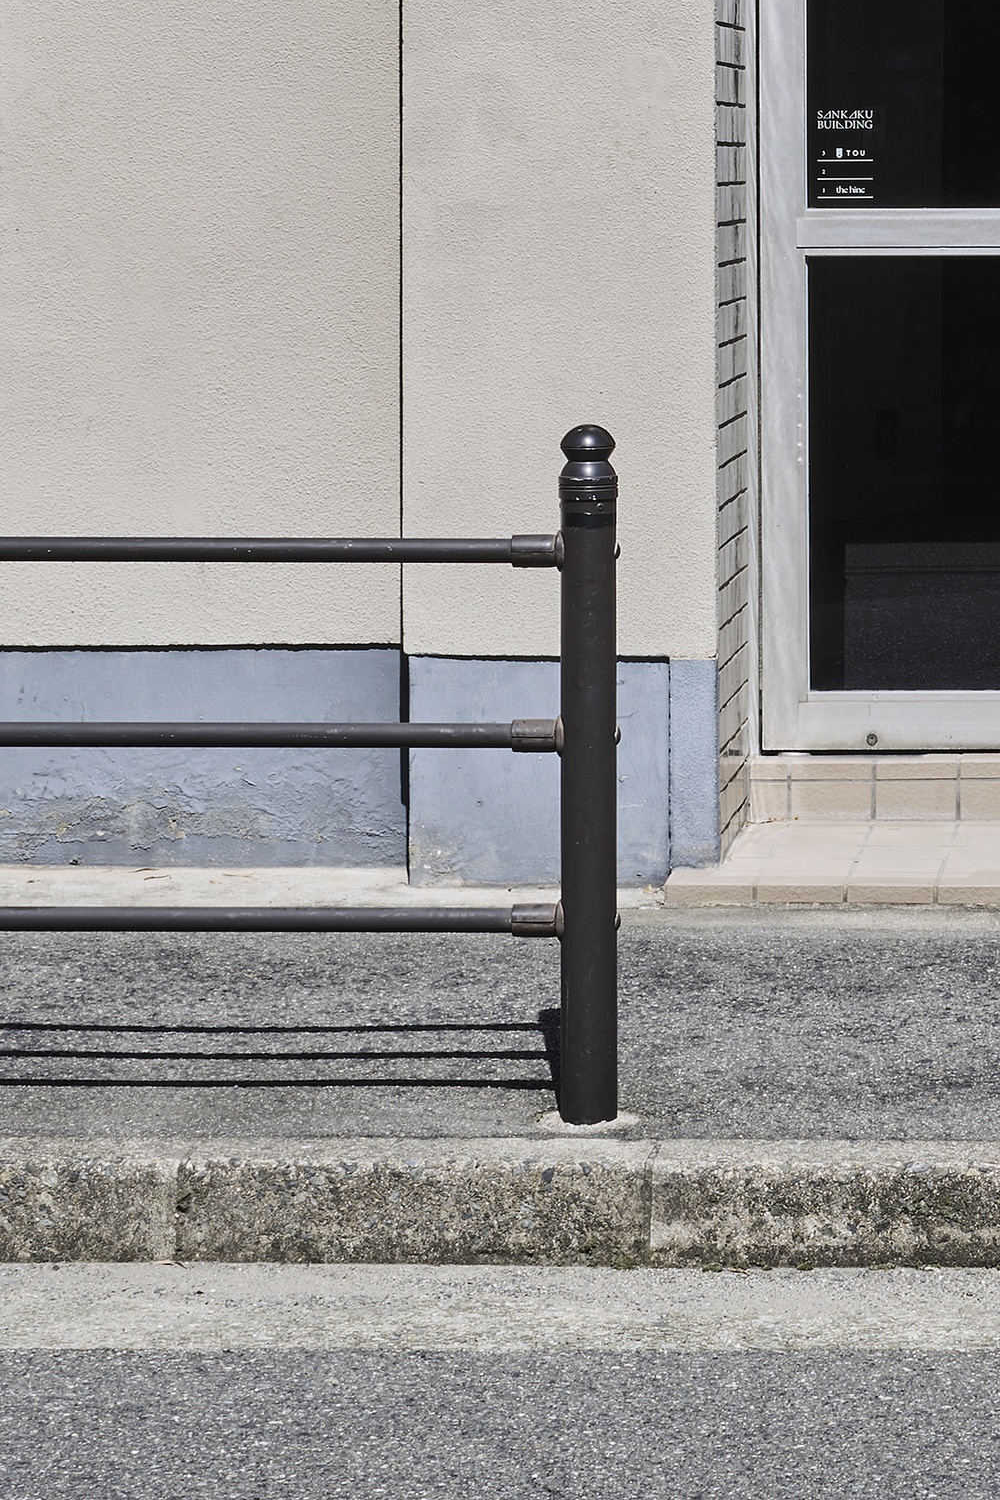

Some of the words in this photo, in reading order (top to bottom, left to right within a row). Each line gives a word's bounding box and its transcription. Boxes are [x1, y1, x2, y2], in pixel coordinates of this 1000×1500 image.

[817, 110, 873, 119] SANKAKU
[817, 120, 873, 129] BUILDING
[846, 149, 866, 157] TOU
